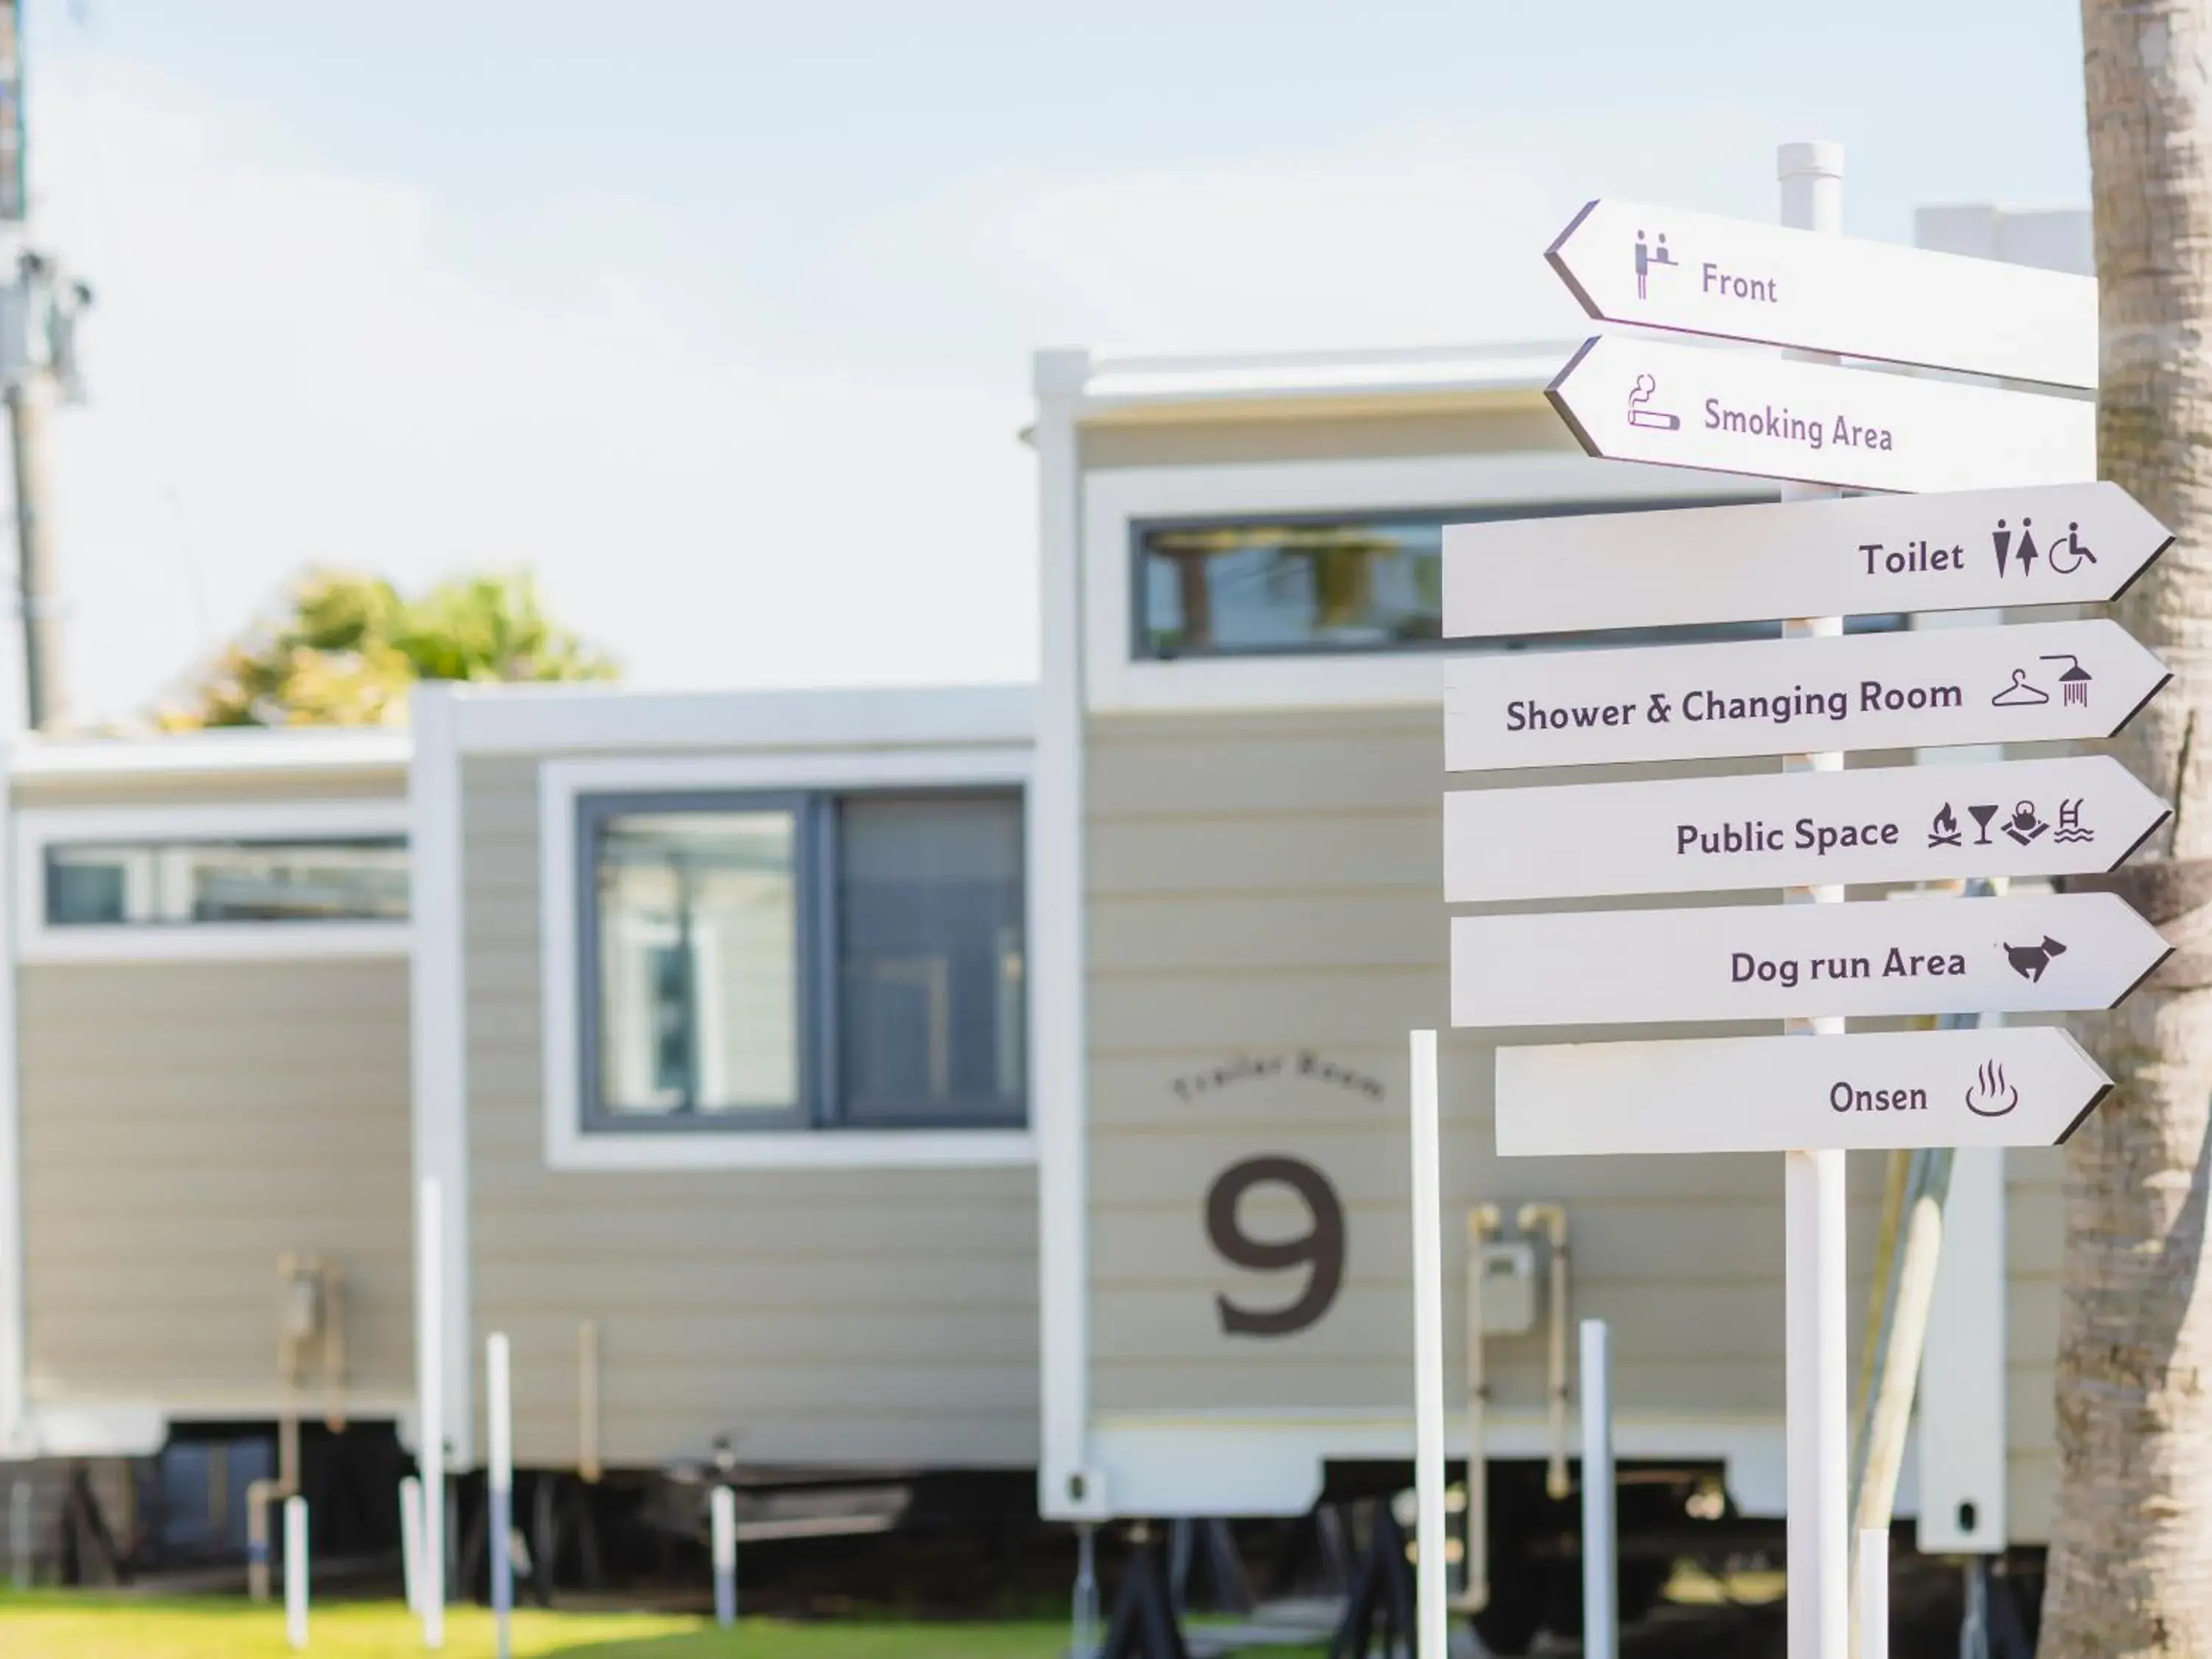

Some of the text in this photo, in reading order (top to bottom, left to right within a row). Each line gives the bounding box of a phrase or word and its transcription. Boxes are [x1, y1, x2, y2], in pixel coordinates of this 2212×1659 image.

[1702, 262, 1778, 304] Front
[1705, 398, 1893, 452] Smoking Area
[1859, 540, 1964, 575] Toilet
[1506, 680, 1963, 731] Shower & Changing Room
[1677, 817, 1899, 856] Public Space
[1731, 947, 1966, 989] Dog run Area
[1830, 1081, 1928, 1113] Onsen
[1203, 1154, 1348, 1339] 9
